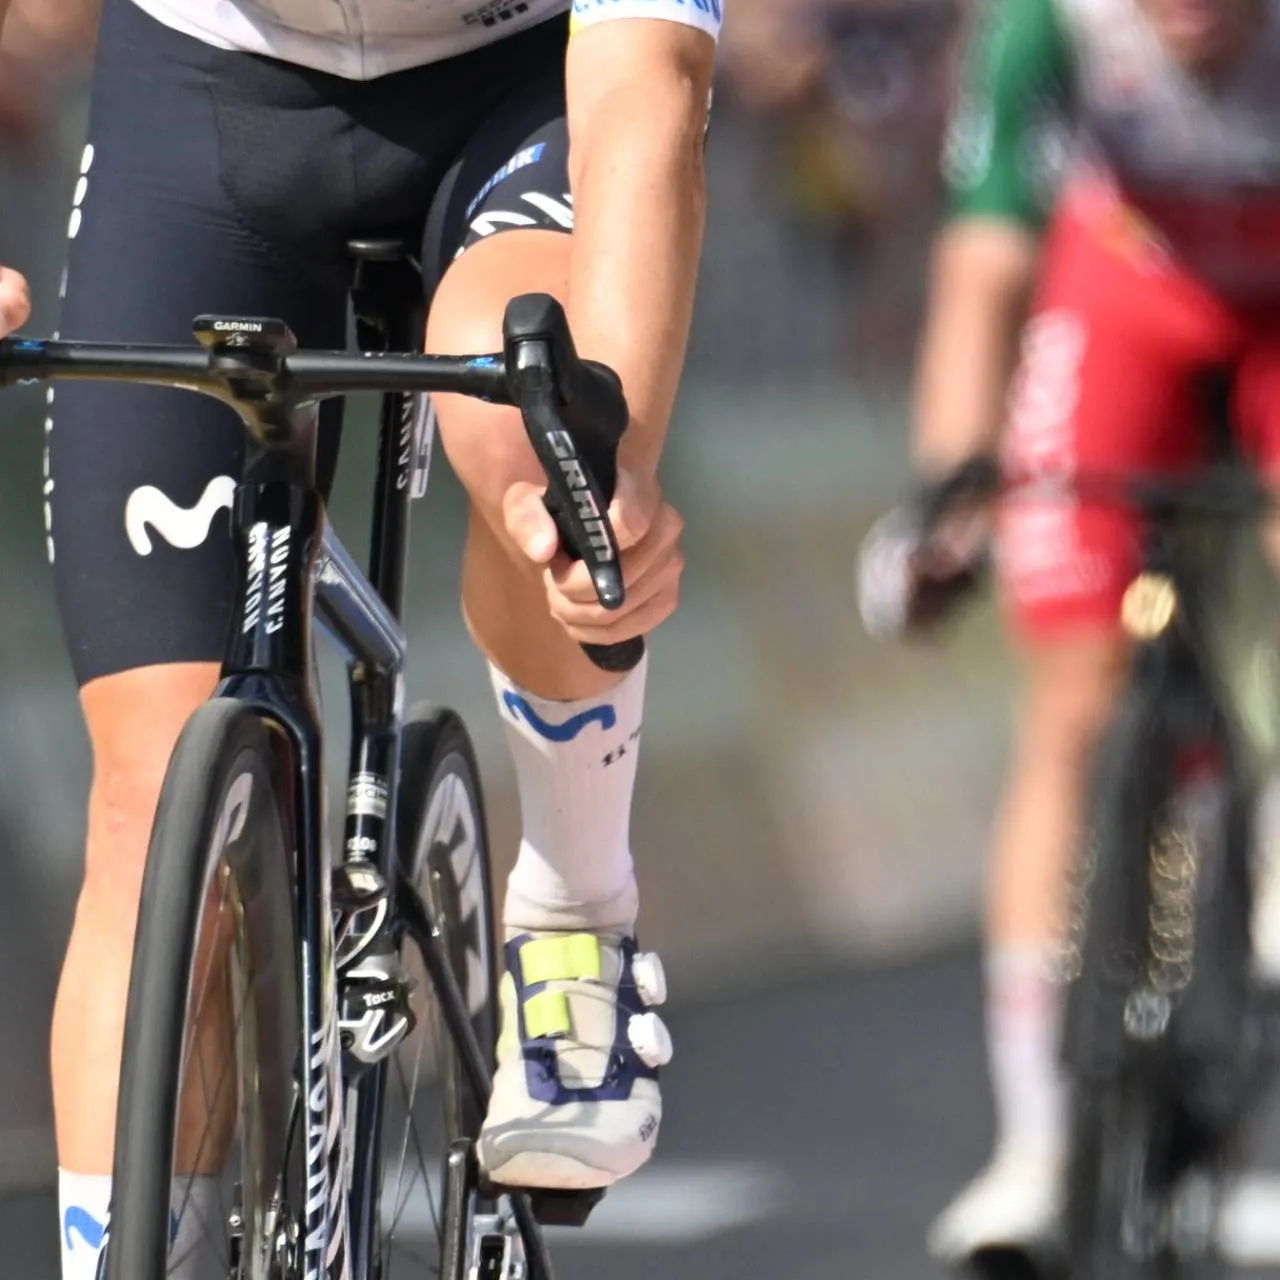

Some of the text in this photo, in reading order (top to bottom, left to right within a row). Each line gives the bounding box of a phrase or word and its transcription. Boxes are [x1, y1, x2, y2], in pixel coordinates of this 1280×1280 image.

[213, 320, 263, 333] GARMIN
[265, 524, 292, 634] CANYON
[362, 990, 396, 1008] Tacx
